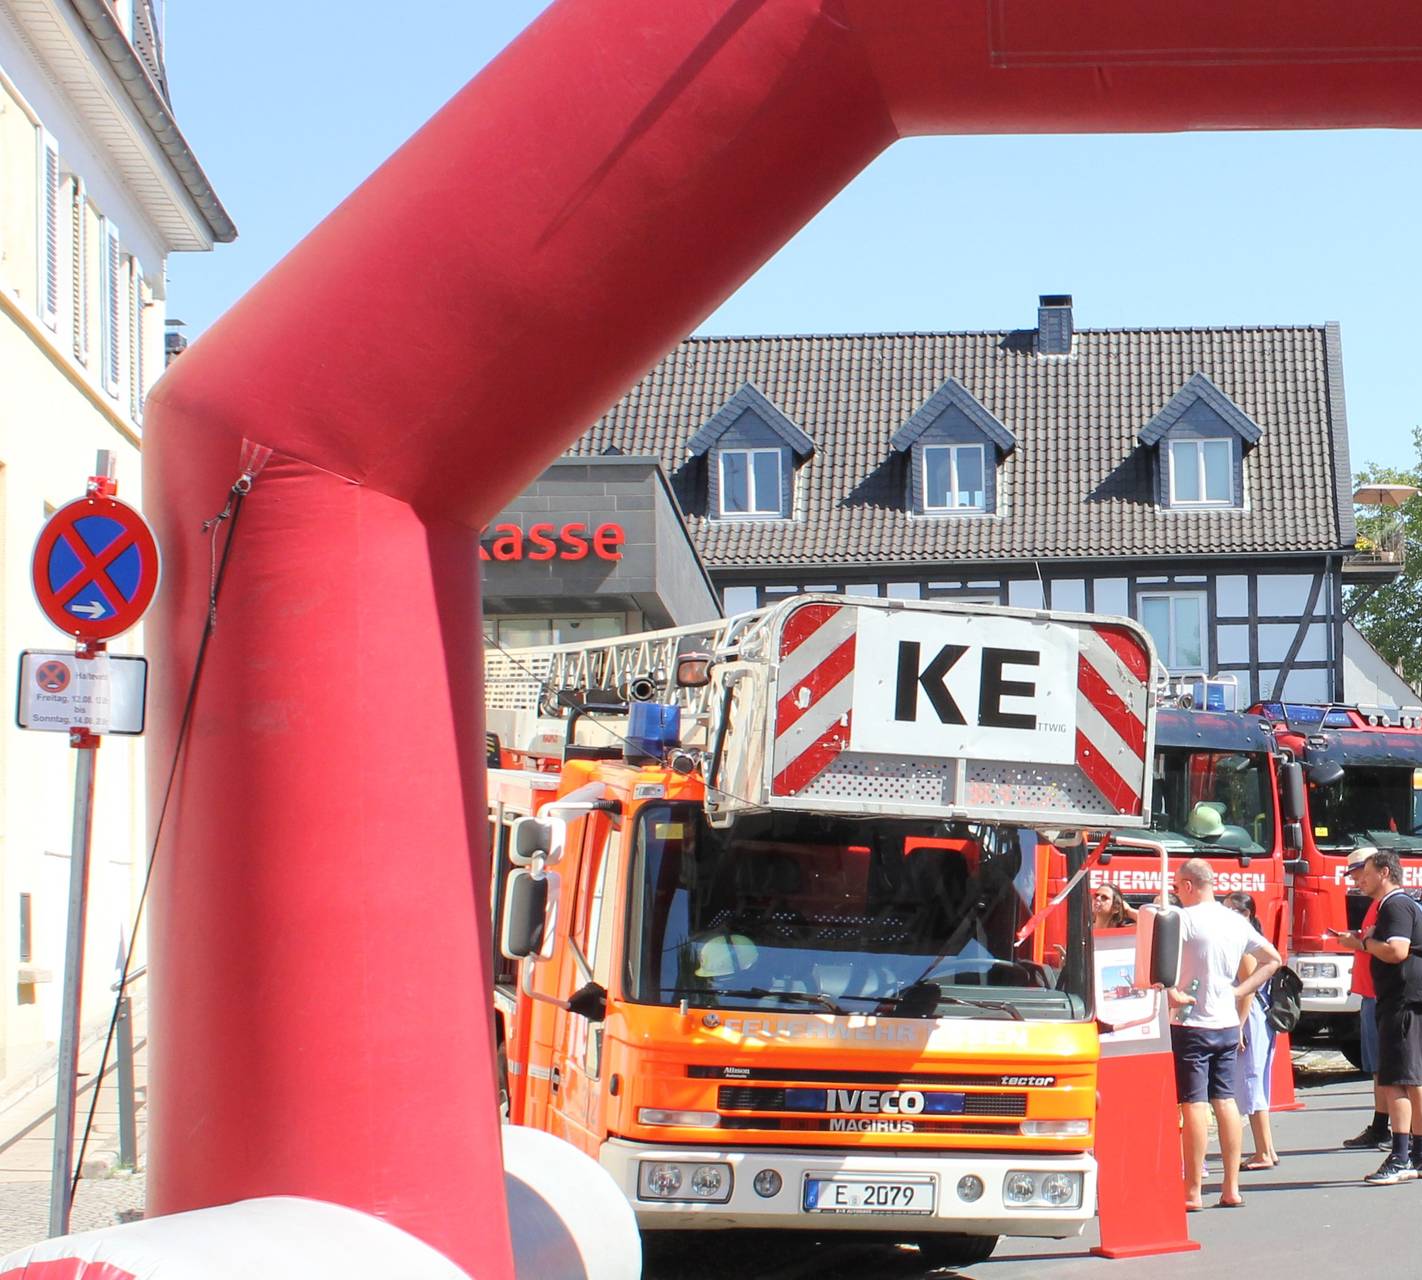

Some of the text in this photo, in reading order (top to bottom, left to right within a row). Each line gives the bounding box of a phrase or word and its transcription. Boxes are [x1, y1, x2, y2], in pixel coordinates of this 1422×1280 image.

[1090, 870, 1265, 891] EUERWE ESSEN
[1001, 1076, 1054, 1086] tector
[826, 1089, 925, 1114] IVECO
[829, 1119, 914, 1132] MAGIRUS
[835, 1185, 915, 1206] E 2079
